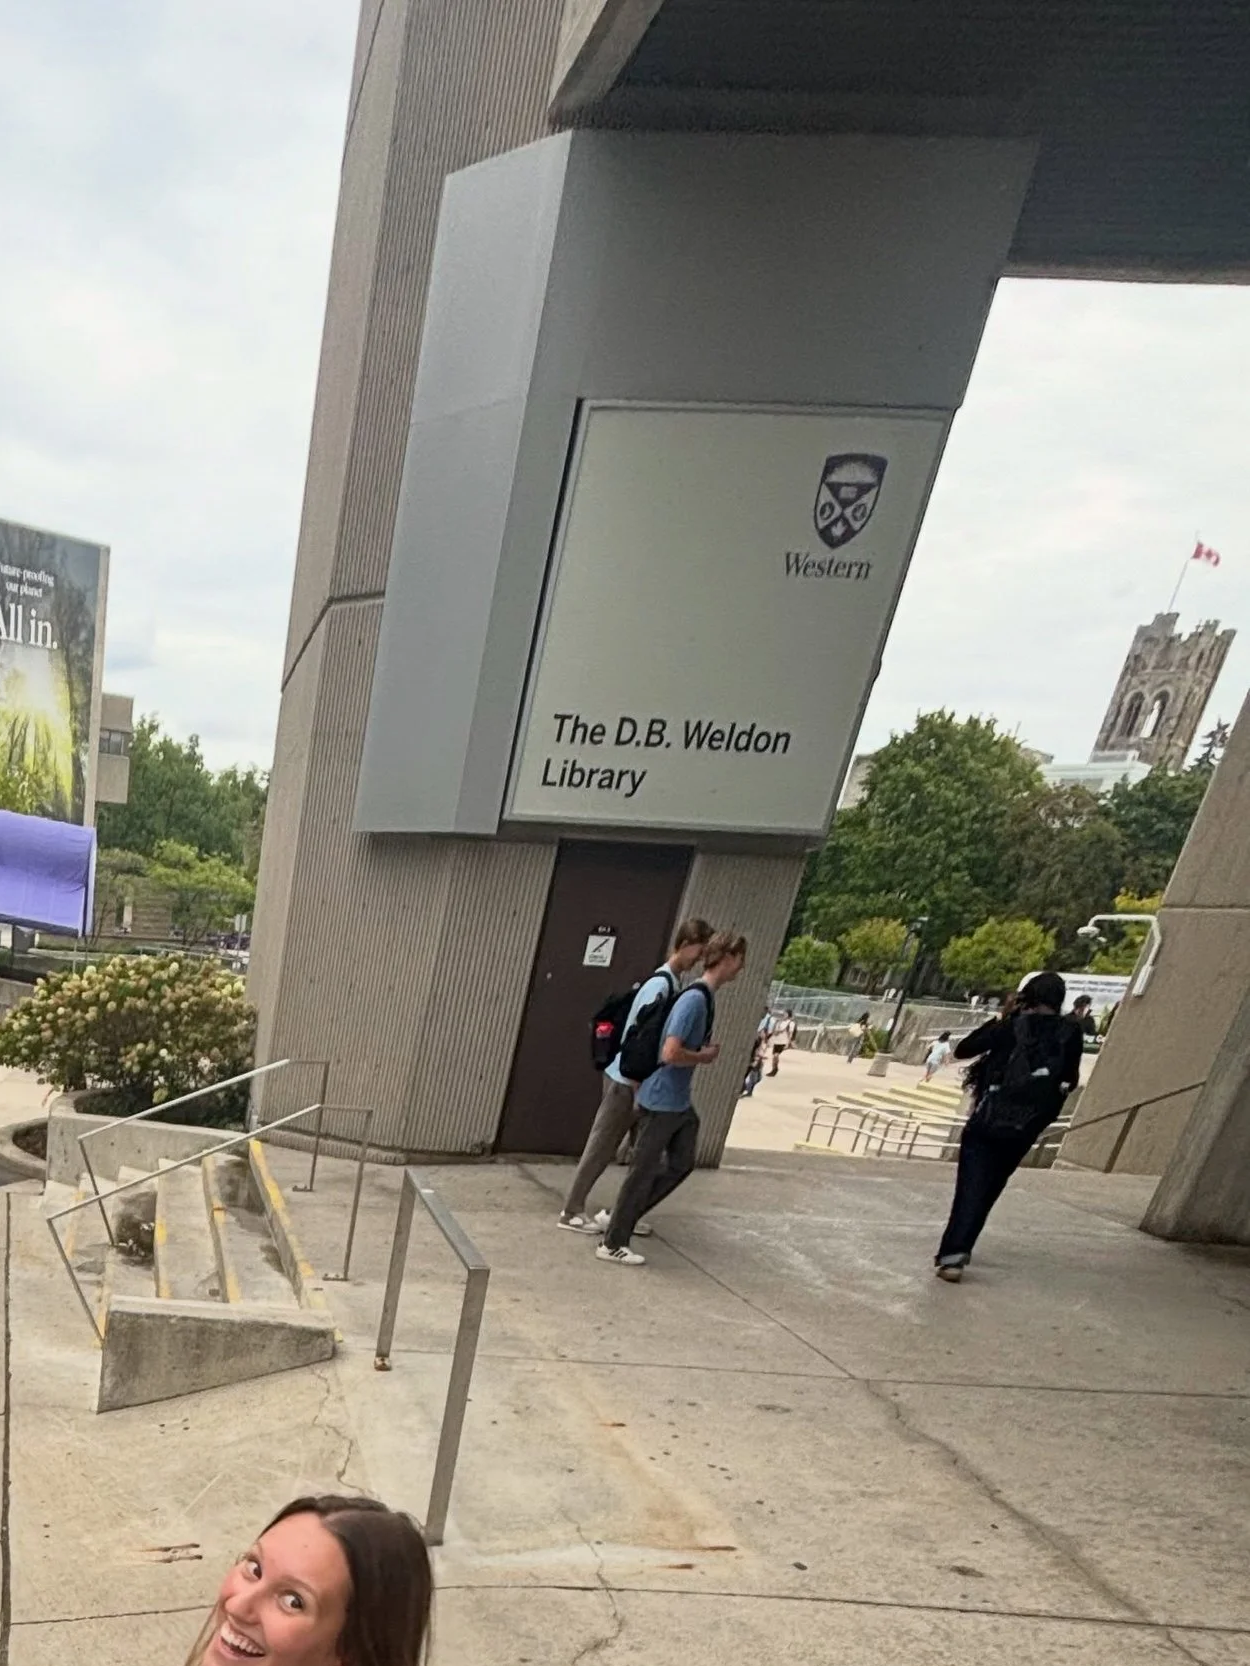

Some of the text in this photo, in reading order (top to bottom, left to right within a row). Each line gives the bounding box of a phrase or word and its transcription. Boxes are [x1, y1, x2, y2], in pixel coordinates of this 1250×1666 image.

[785, 551, 873, 580] Western
[29, 608, 58, 650] in.
[553, 713, 792, 755] The D.B. Weldon
[541, 758, 648, 799] Library
